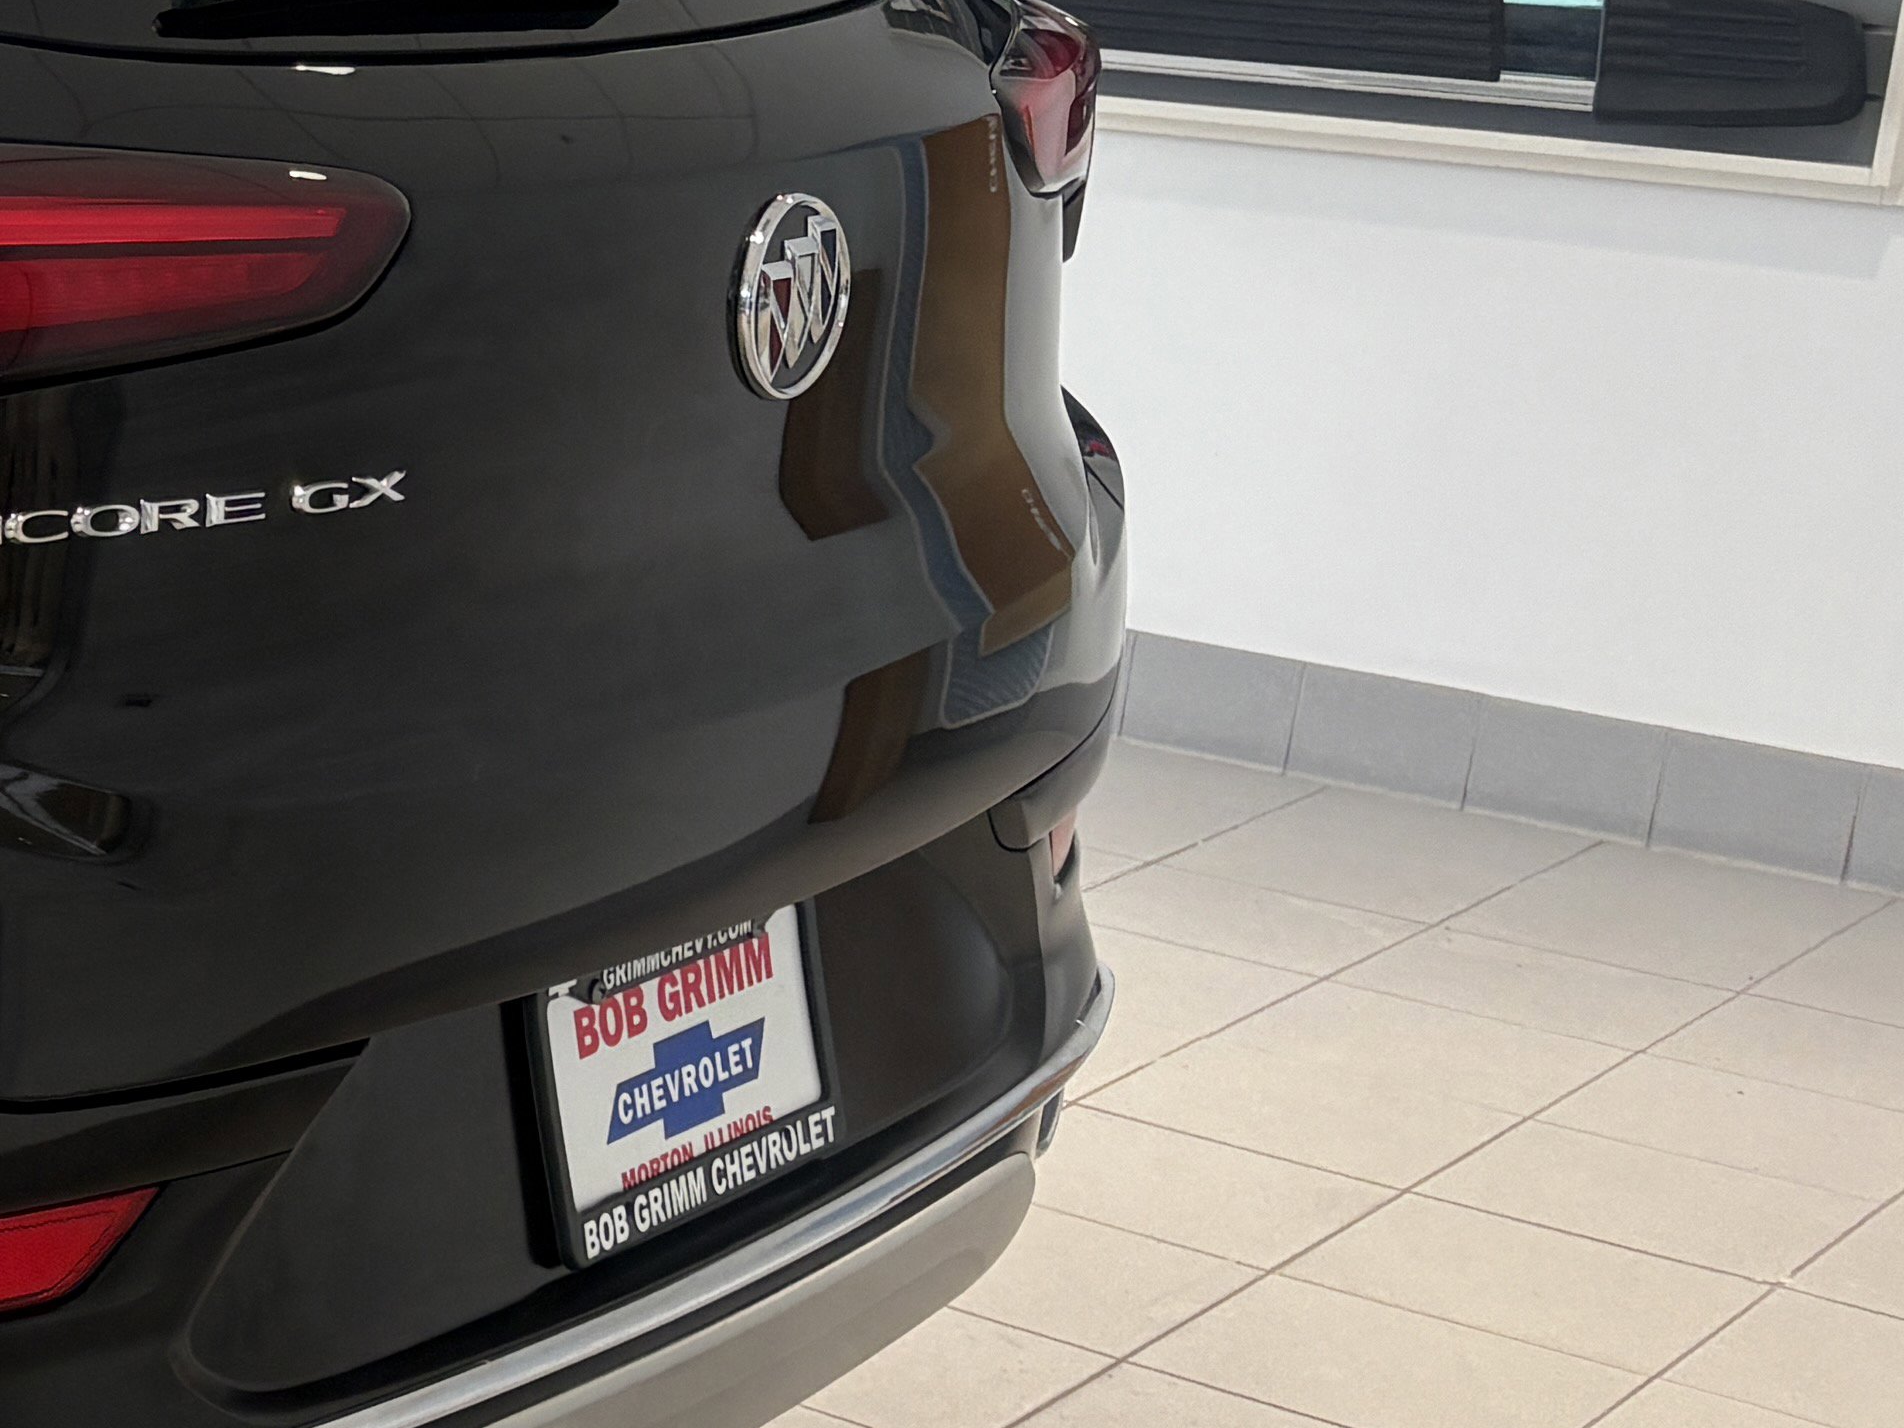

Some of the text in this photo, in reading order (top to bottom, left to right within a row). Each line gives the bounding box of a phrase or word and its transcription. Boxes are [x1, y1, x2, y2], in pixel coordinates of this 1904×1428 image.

[290, 470, 407, 515] GX
[573, 932, 774, 1060] BOB GRIMM
[617, 1037, 754, 1125] CHEVROLET
[703, 1105, 775, 1154] ILLINOIS
[583, 1105, 836, 1260] BOB GRIMM CHEVROLET
